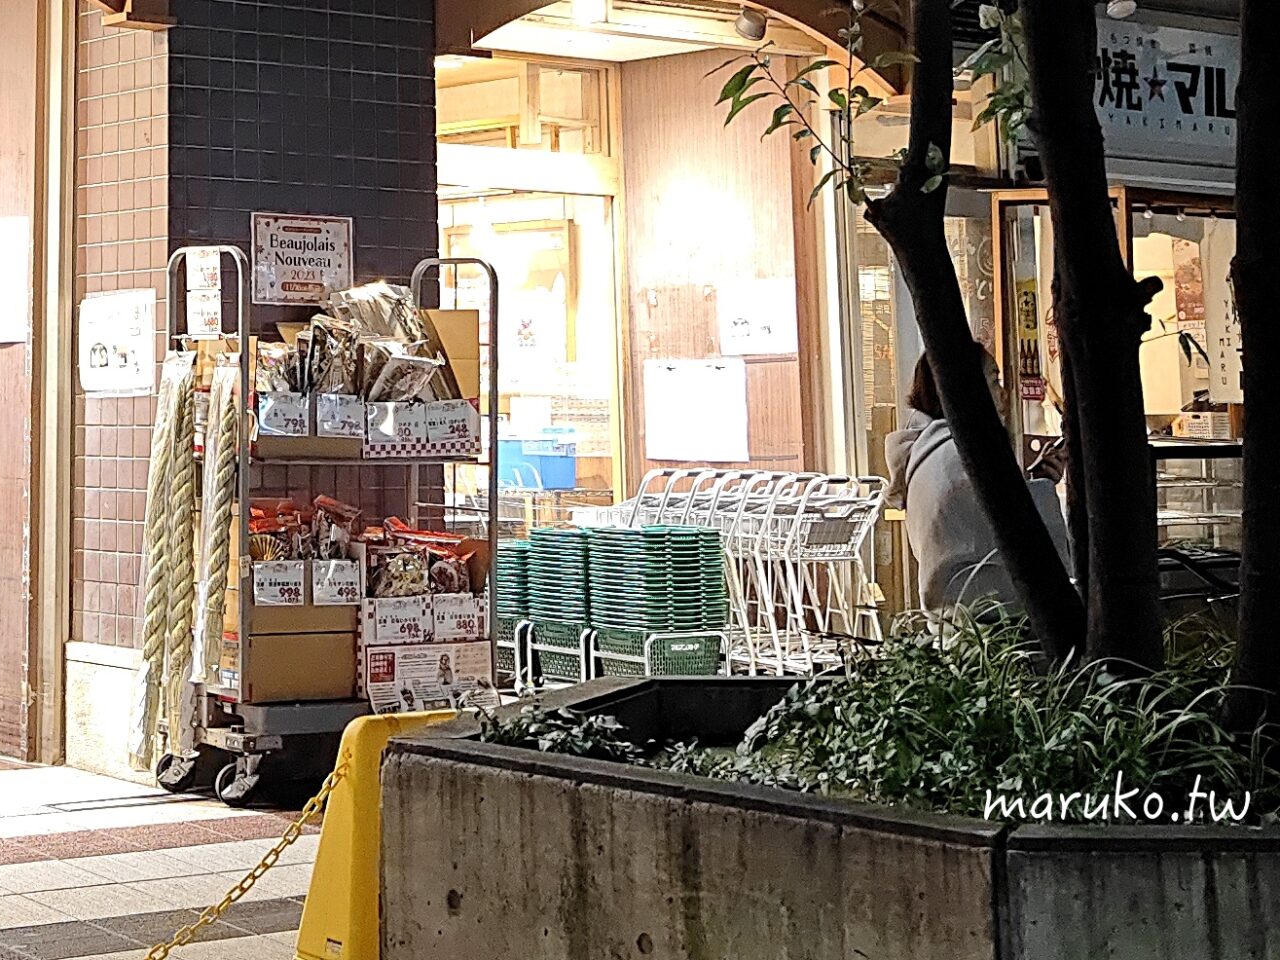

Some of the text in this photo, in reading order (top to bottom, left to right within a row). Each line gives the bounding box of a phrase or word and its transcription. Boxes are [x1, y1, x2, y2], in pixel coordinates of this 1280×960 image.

[269, 233, 336, 254] Beaujolais
[274, 251, 331, 268] Nouveau
[290, 269, 316, 281] 2023
